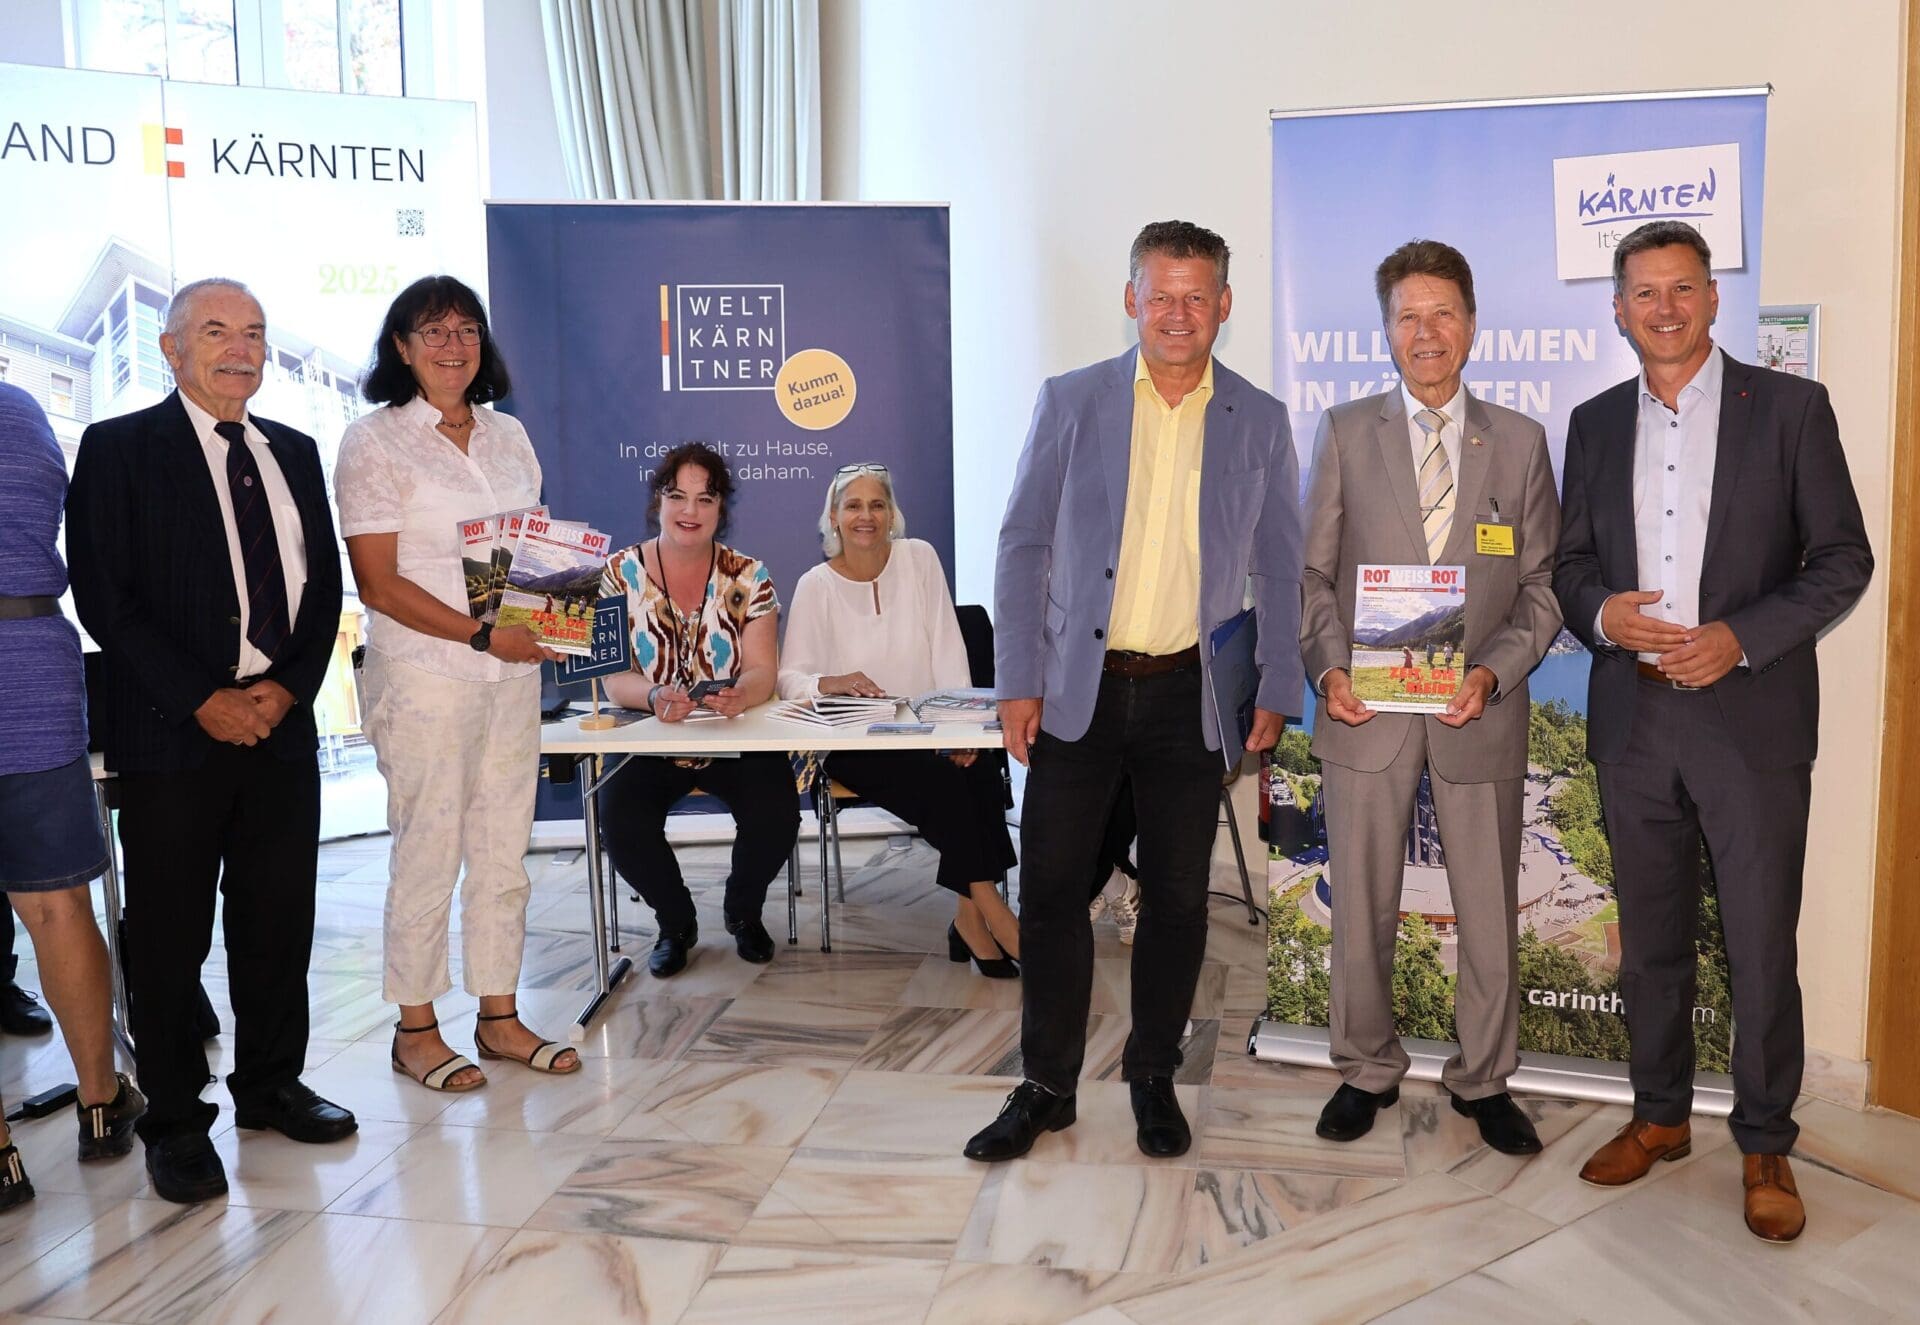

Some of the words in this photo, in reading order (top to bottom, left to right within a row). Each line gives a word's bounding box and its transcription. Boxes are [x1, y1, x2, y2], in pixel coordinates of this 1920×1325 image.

[211, 133, 425, 183] KÄRNTEN
[1578, 167, 1717, 217] KÄRNTEN
[318, 263, 399, 295] 2025
[689, 296, 773, 316] WELT
[689, 324, 774, 348] KÄRN
[1289, 328, 1597, 362] WILLMMEN
[690, 359, 774, 379] TNER
[787, 371, 840, 396] Kumm
[1291, 380, 1335, 413] IN
[792, 385, 846, 412] dazua!
[619, 441, 638, 459] In
[683, 440, 730, 457] elt
[736, 443, 759, 457] zu
[766, 440, 833, 457] Hause,
[738, 463, 815, 480] daham.
